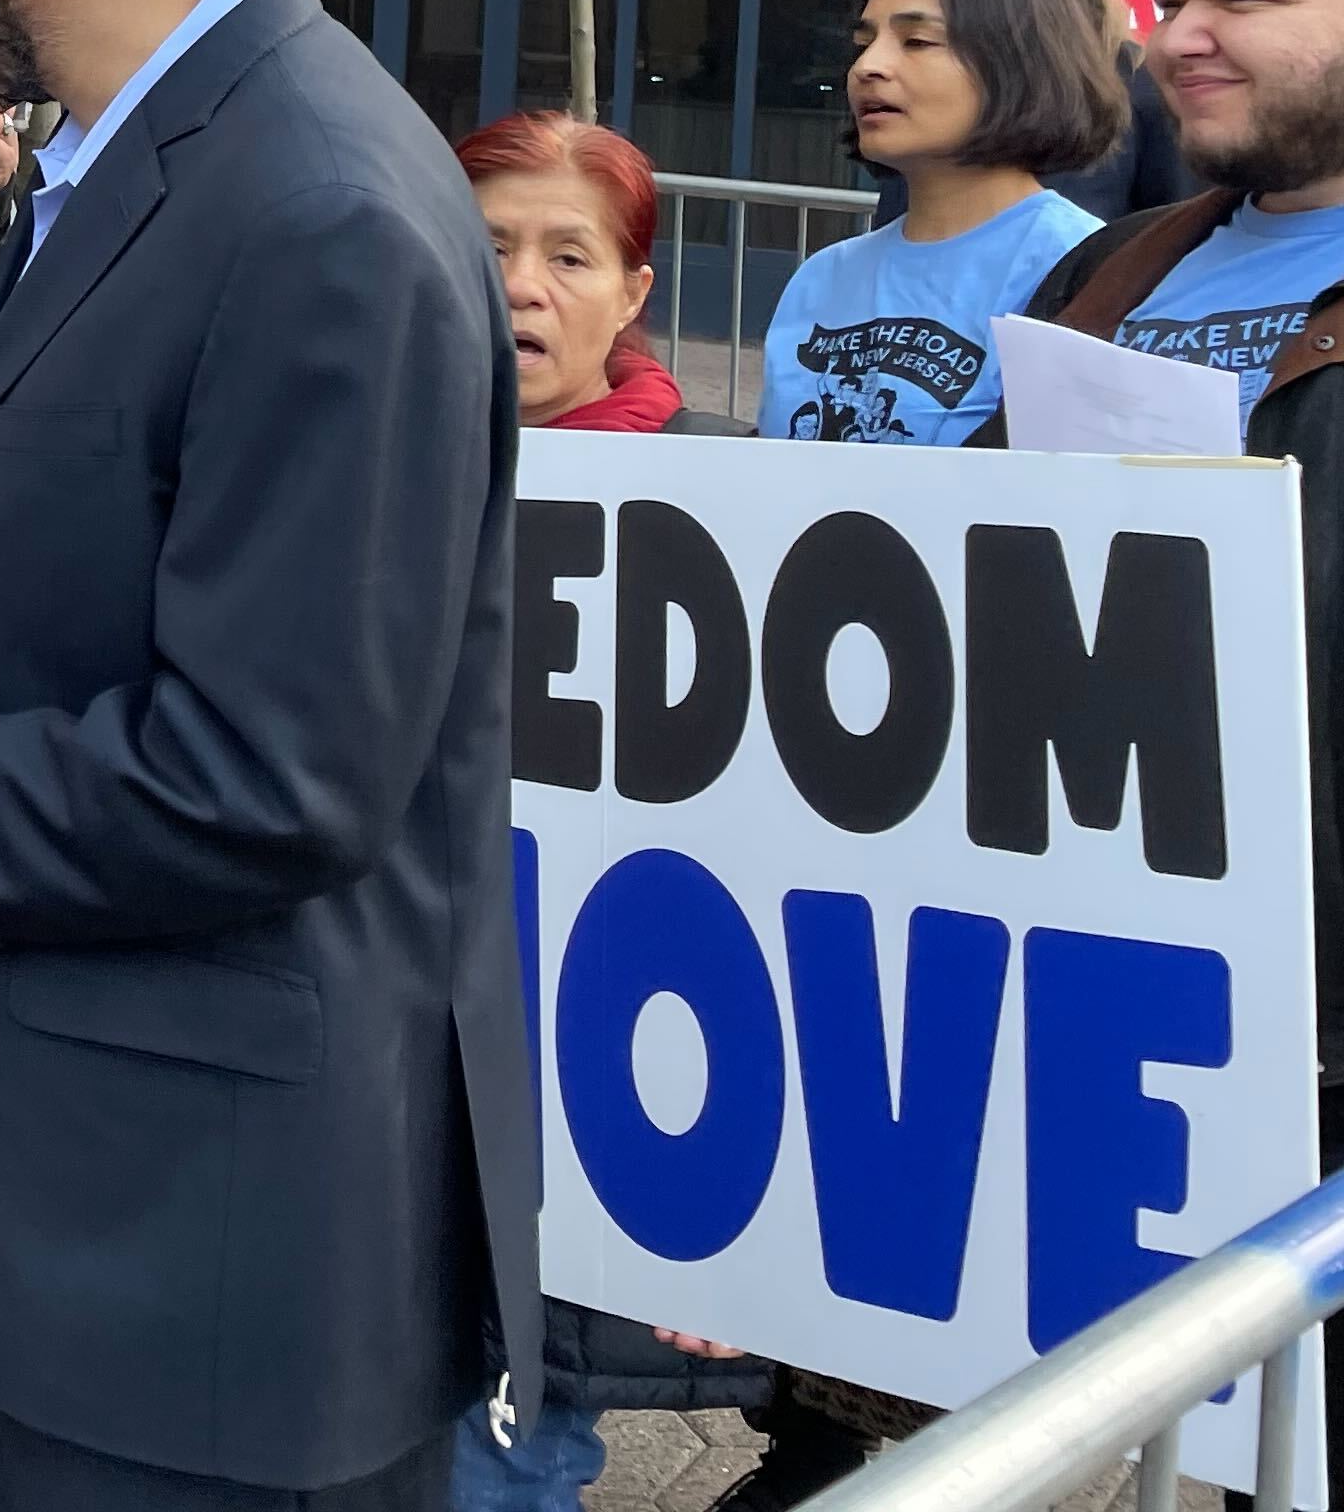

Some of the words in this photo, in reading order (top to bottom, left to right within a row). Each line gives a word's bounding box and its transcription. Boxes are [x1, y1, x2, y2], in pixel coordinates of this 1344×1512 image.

[809, 331, 864, 354] MAKE
[869, 325, 915, 345] THE
[912, 328, 979, 377] ROAD
[1129, 324, 1231, 354] MAKE
[1239, 312, 1309, 341] THE
[1208, 341, 1281, 368] NEW
[851, 348, 892, 369] NEW
[893, 351, 963, 393] JERSEY
[512, 497, 1229, 881] EDOM
[510, 826, 1235, 1406] OVE
